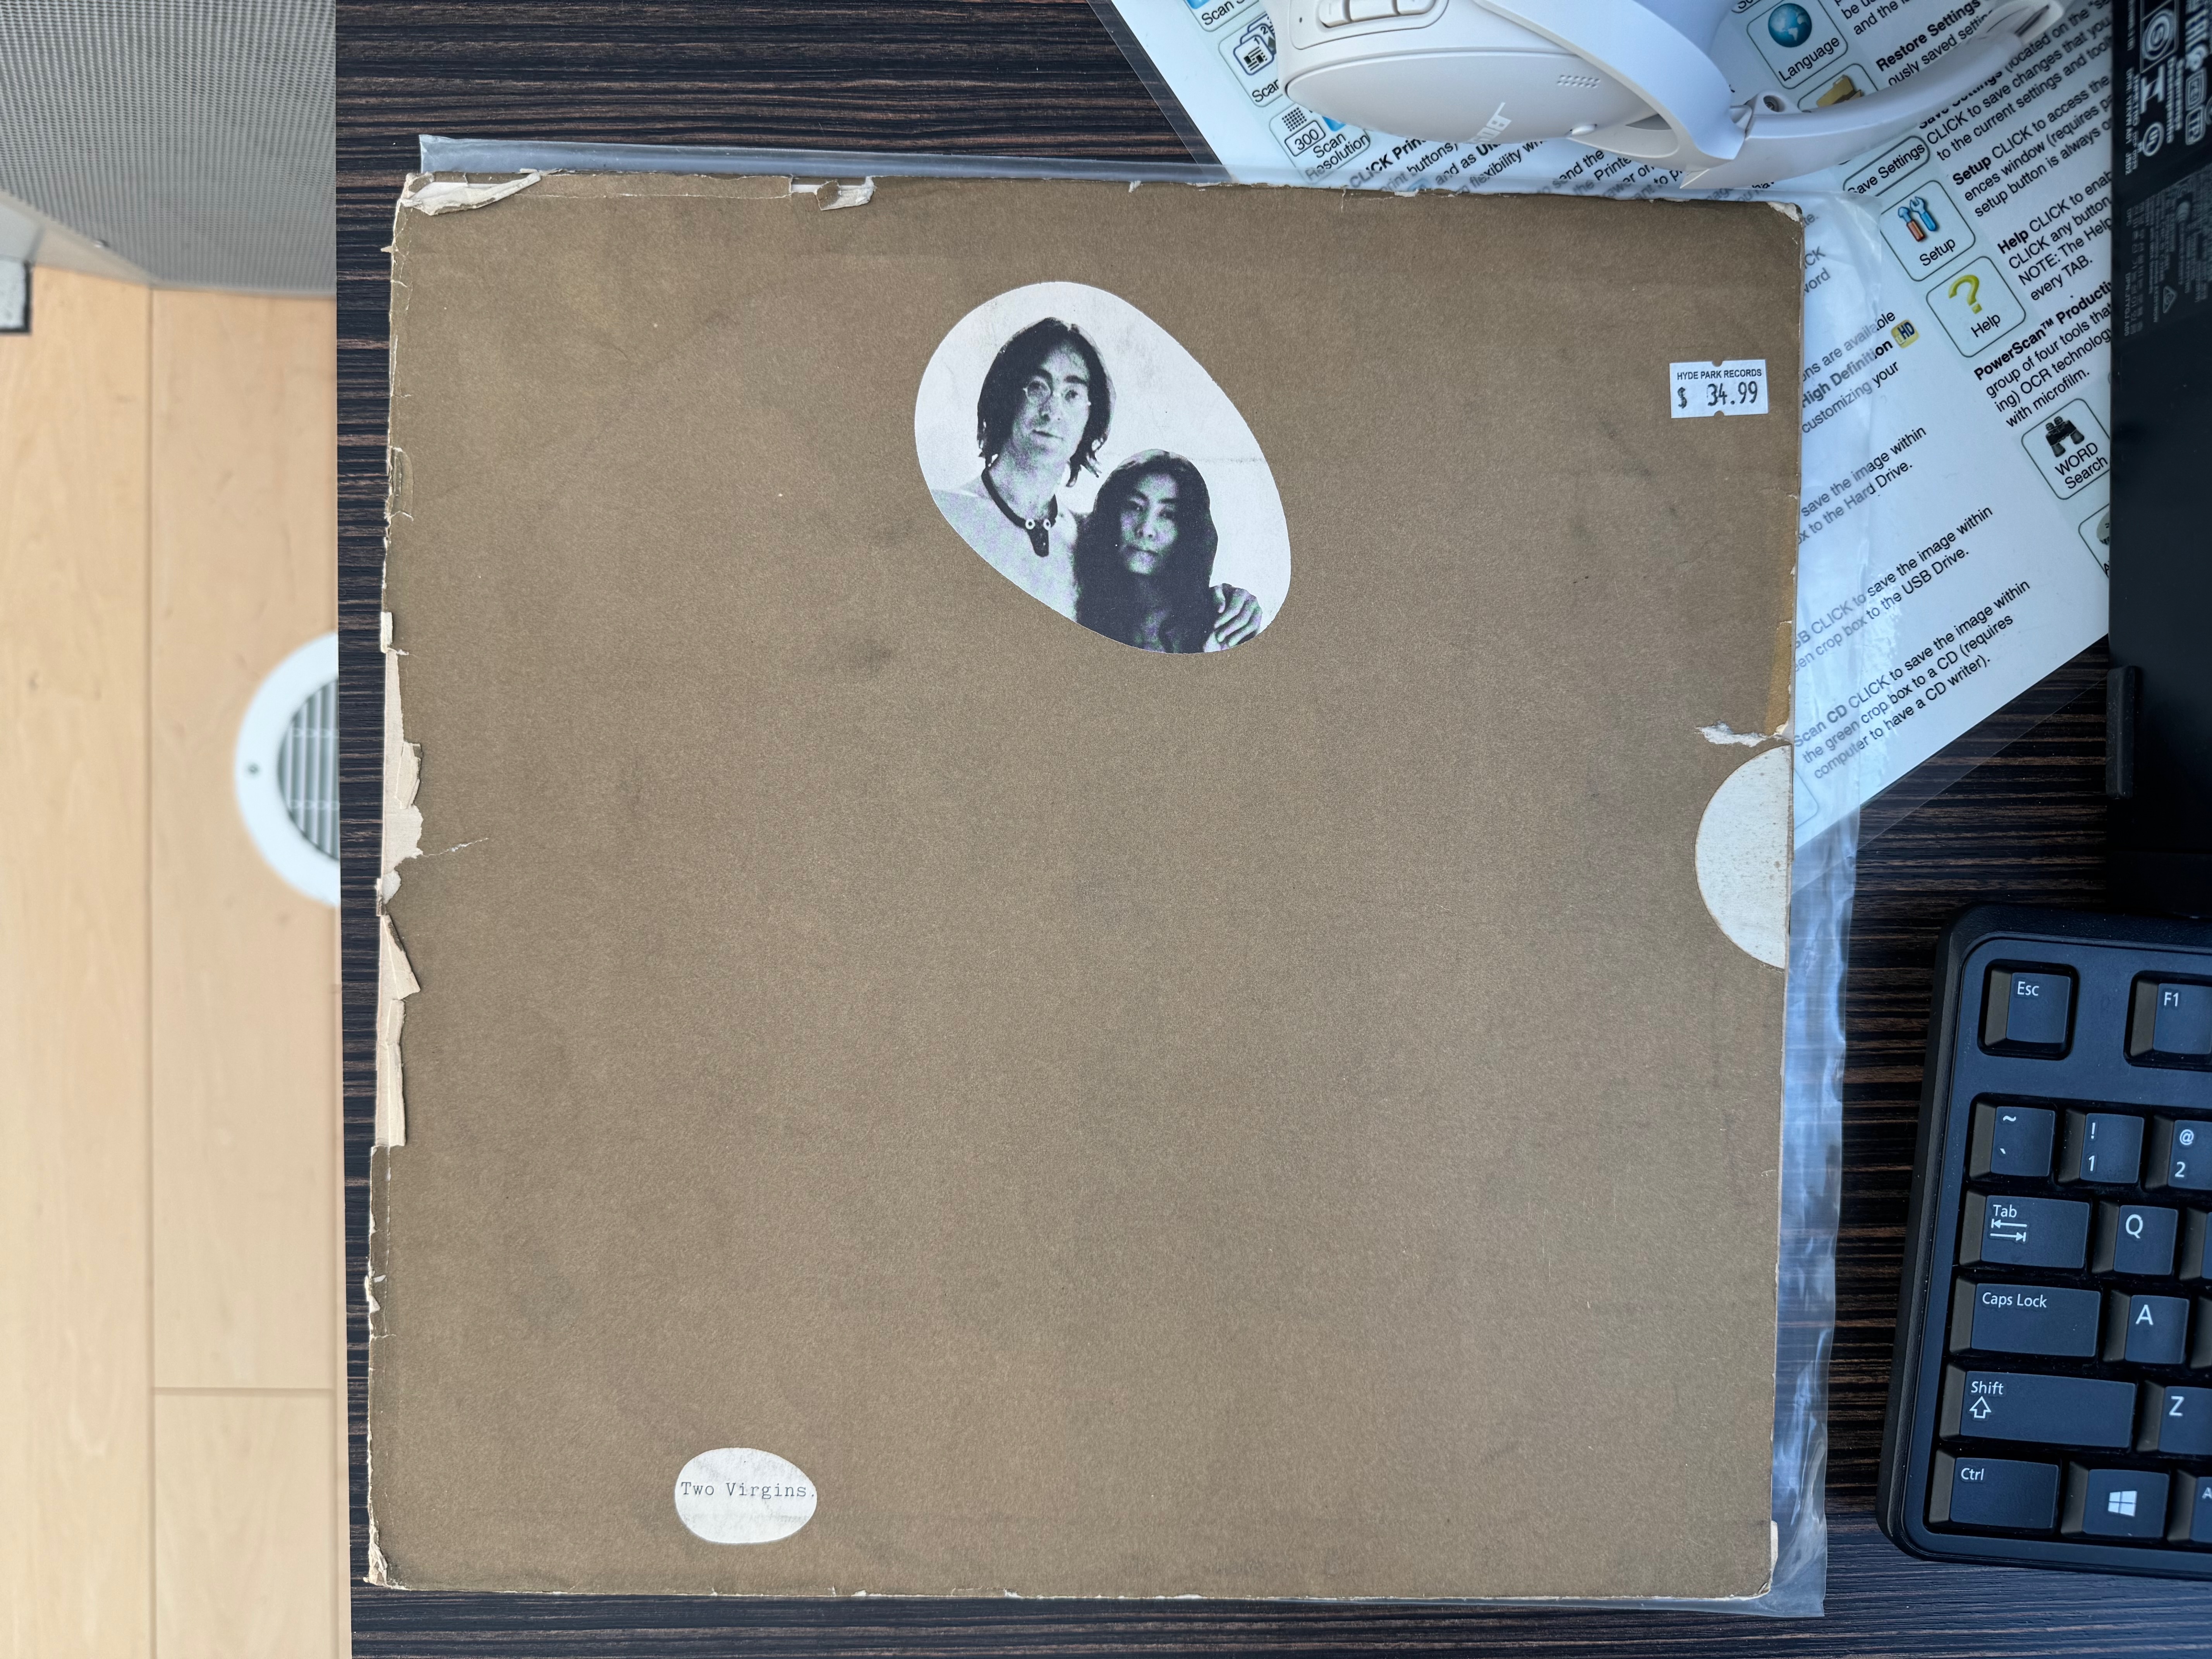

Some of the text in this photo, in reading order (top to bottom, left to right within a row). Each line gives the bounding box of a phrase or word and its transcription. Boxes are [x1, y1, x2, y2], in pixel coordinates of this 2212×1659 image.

[1841, 3, 1860, 20] be
[1853, 0, 1899, 36] and the
[2051, 22, 2069, 38] on
[2067, 8, 2090, 27] the
[1778, 37, 1841, 82] Language
[1875, 33, 1928, 72] Restore
[1920, 33, 1959, 65] saved
[1926, 111, 1969, 145] CLICK
[1966, 104, 1982, 118] to
[1982, 84, 2011, 108] save
[2011, 49, 2064, 89] changes
[2061, 31, 2088, 54] that
[1936, 148, 1951, 161] to
[1950, 133, 1973, 151] the
[1972, 102, 2016, 137] current
[2015, 72, 2063, 109] settings
[2062, 53, 2088, 77] and
[1294, 128, 1321, 151] 300
[1312, 132, 1346, 158] Scan
[1952, 156, 1992, 186] Setup
[1991, 125, 2034, 160] CLICK
[2031, 118, 2047, 132] to
[2046, 89, 2090, 123] access
[2088, 75, 2112, 94] the
[1306, 135, 1369, 179] Resolution
[1434, 153, 1477, 185] and as
[1470, 149, 1522, 187] flexibility
[1552, 149, 1605, 187] send the
[1877, 143, 1928, 179] Settings
[1964, 172, 2001, 202] ences
[2000, 141, 2046, 176] window
[2045, 105, 2101, 148] (requires
[1974, 127, 2102, 218] setup button is always
[1997, 192, 2084, 255] Help CLICK to
[1919, 238, 1956, 267] Setup
[2008, 235, 2051, 270] CLICK
[2049, 222, 2073, 243] any
[2018, 252, 2061, 286] NOTE:
[2057, 237, 2085, 258] The
[2030, 254, 2093, 301] every TAB.
[1821, 311, 1896, 366] are available
[1970, 313, 2002, 338] Help
[1677, 369, 1762, 380] HYDE PARK RECORDS
[1830, 340, 1893, 385] Definition
[1985, 320, 2090, 399] group of four tools
[1677, 381, 1758, 409] $ 34.99
[1799, 361, 1900, 433] customizing your
[1994, 368, 2053, 413] ing) OCR
[2005, 368, 2090, 428] with microfilm.
[1798, 426, 1927, 517] save the image within
[2054, 442, 2099, 476] WORD
[2064, 456, 2110, 489] Search
[1808, 461, 1913, 534] to the Hard Drive.
[1810, 507, 1993, 635] CLICK to save the image within
[1815, 547, 1970, 656] crop box to the USB Drive.
[1792, 580, 2031, 747] Scan CD CLICK to save the image within
[1802, 615, 2014, 764] the green crop box to a CD (requires
[1812, 653, 1991, 779] computer to have a CD writer).
[2017, 981, 2039, 996] Esc
[2164, 992, 2179, 1007] F1
[2179, 1129, 2194, 1146] @
[2088, 1155, 2095, 1171] 1
[2174, 1161, 2185, 1178] 2
[1993, 1204, 2017, 1218] Tab
[2126, 1214, 2143, 1238] Q
[1982, 1292, 2047, 1308] Caps Lock
[2135, 1304, 2154, 1325] A
[1971, 1381, 2004, 1395] Shift
[2169, 1396, 2184, 1416] Z
[681, 1482, 814, 1499] Two Virgins.
[1961, 1468, 1984, 1480] Ctrl
